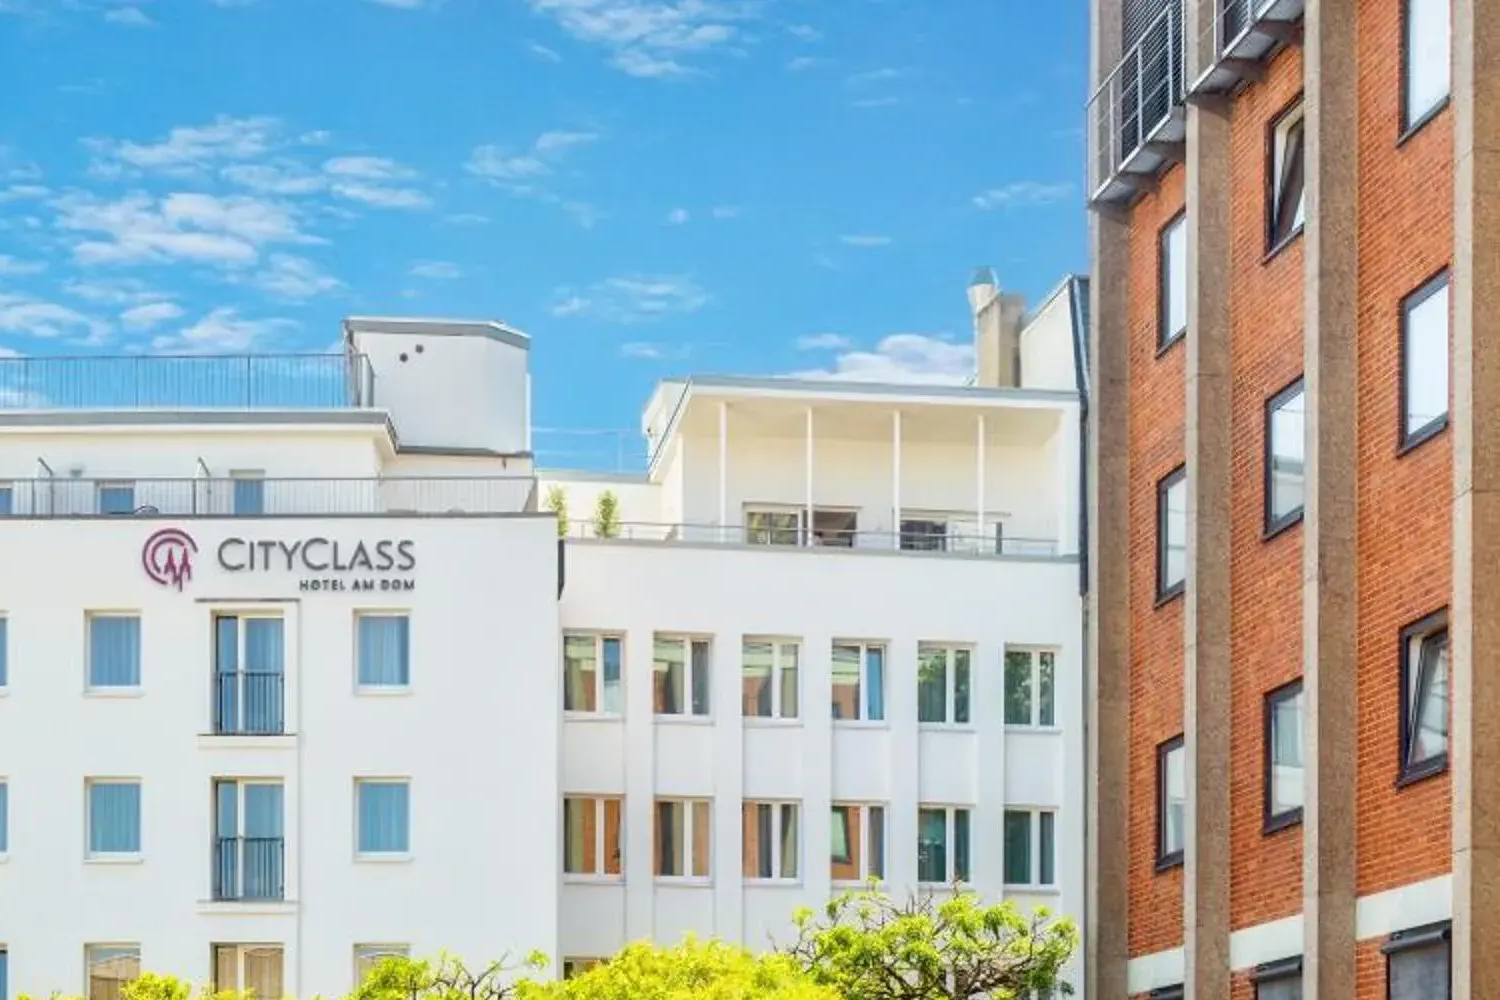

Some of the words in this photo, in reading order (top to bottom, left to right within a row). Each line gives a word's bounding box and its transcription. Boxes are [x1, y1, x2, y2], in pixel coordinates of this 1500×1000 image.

[217, 537, 416, 571] CITYCLASS
[299, 579, 346, 591] HOTEL
[352, 579, 375, 591] AM
[380, 579, 415, 591] DOM
